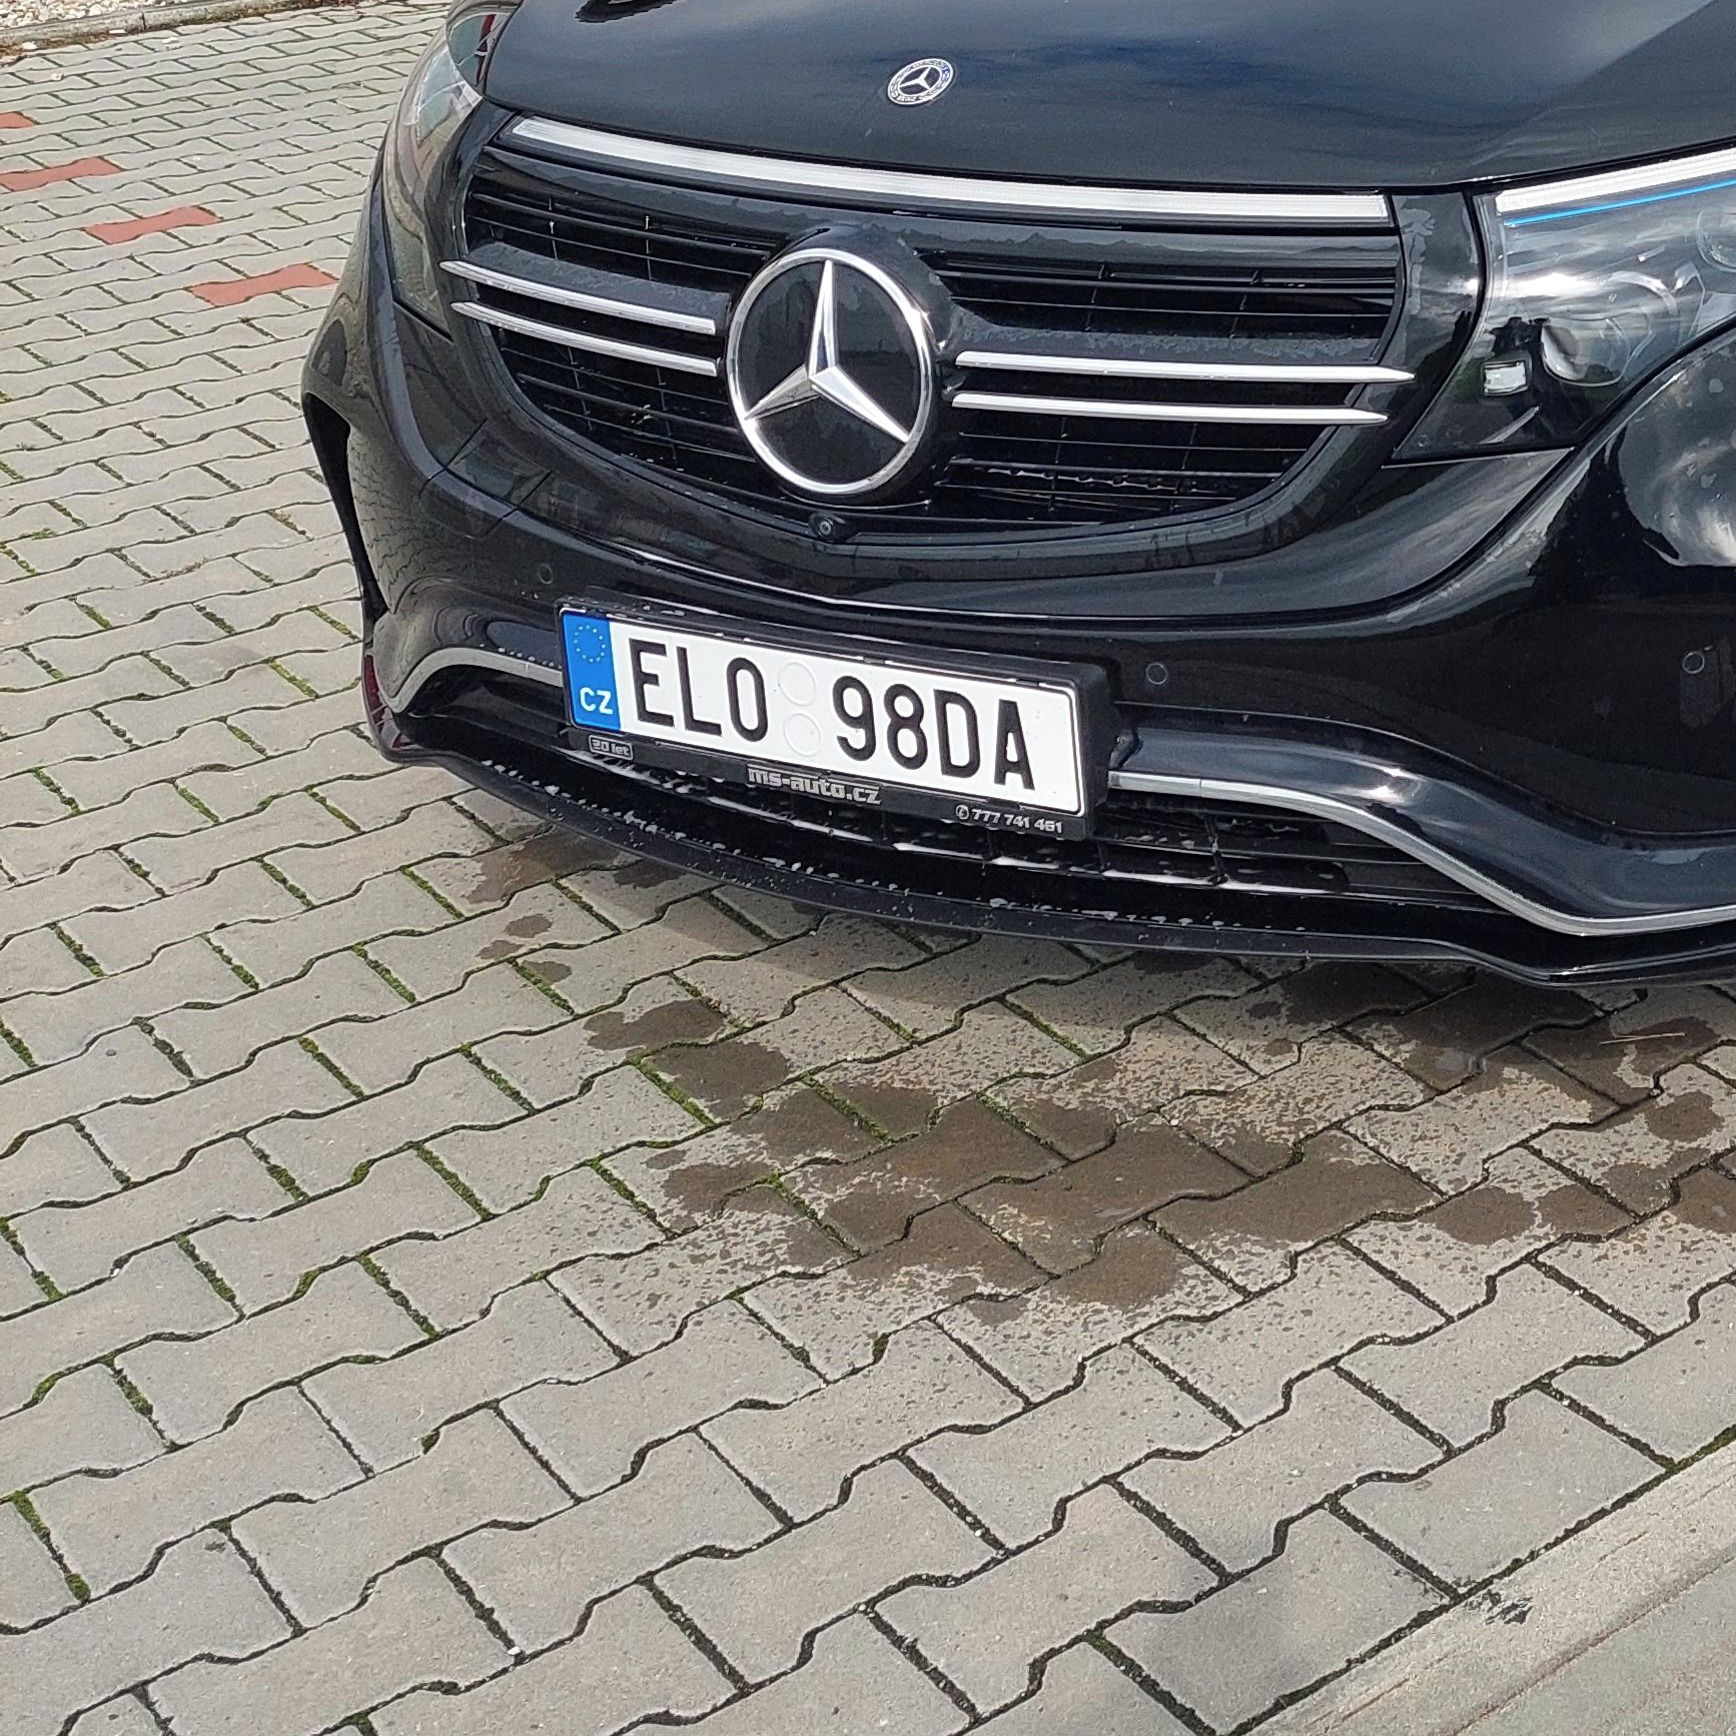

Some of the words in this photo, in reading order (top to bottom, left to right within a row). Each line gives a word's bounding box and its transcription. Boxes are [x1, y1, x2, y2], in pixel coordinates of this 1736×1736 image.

[580, 687, 613, 714] CZ
[832, 675, 1035, 791] 98DA
[747, 768, 881, 805] ms-auto.cz
[971, 808, 1001, 824] 777
[1004, 814, 1030, 829] 741
